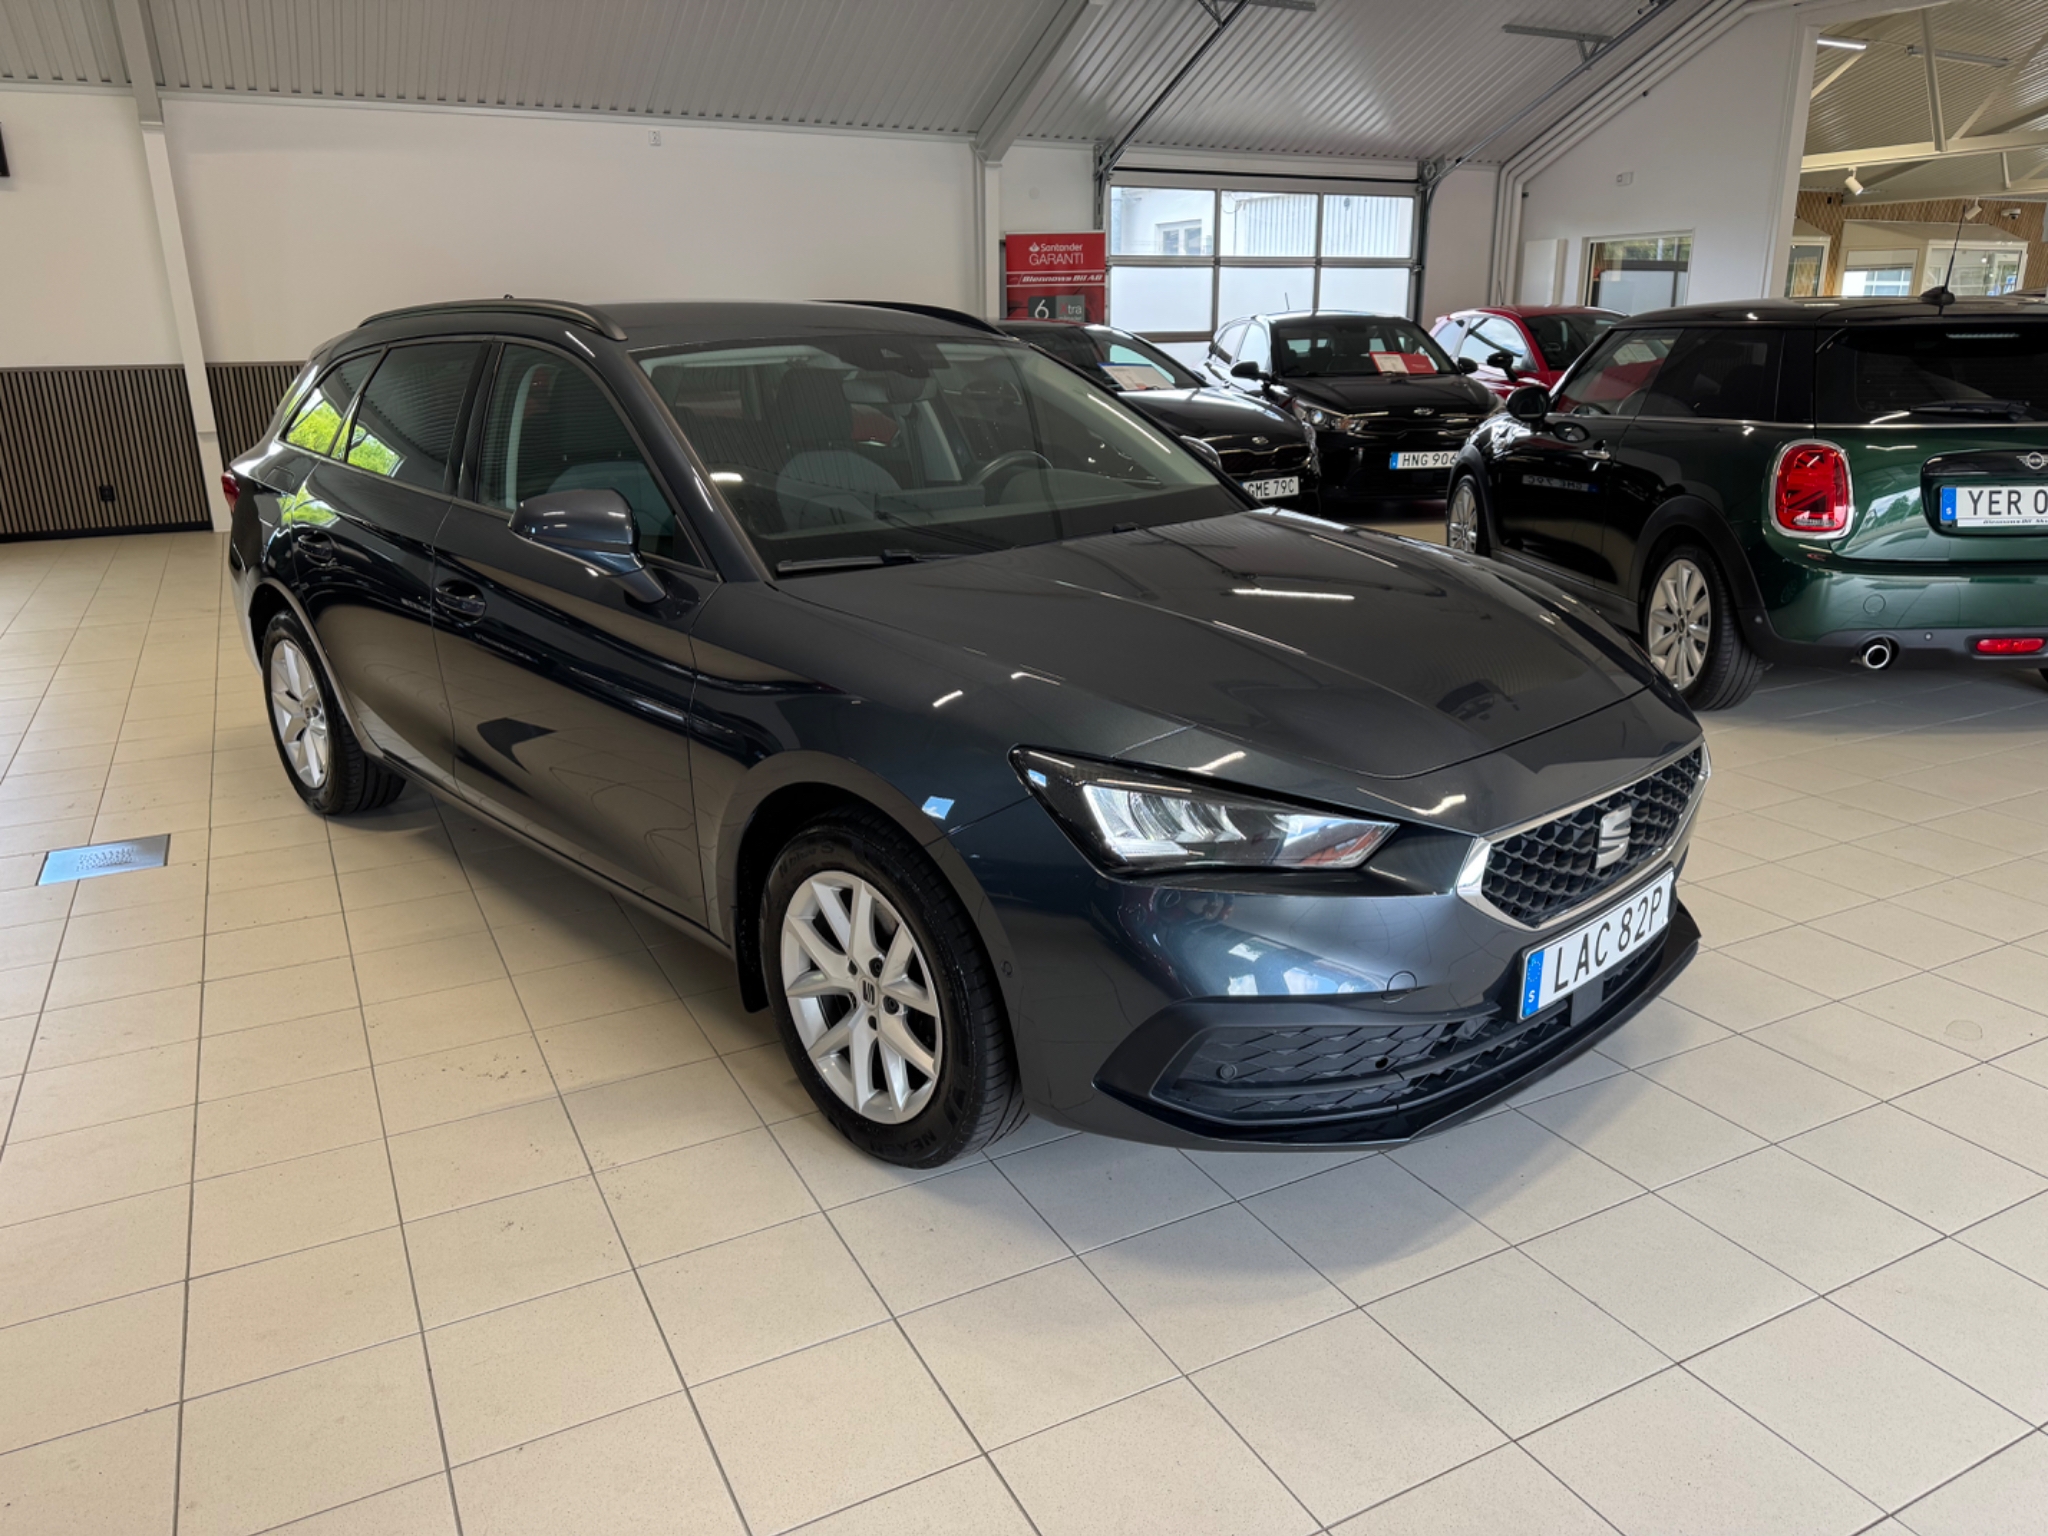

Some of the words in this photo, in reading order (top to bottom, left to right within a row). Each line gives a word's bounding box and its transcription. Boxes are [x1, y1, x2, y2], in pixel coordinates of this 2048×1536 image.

[1040, 243, 1083, 252] Santander
[1029, 252, 1083, 266] GARANTI
[1034, 299, 1050, 319] 6
[1402, 454, 1429, 467] HNG
[1247, 481, 1270, 497] GME
[1273, 478, 1295, 495] 79C
[1967, 489, 2022, 516] YER
[1554, 922, 1611, 993] LAC
[1617, 886, 1663, 952] 82P
[1528, 990, 1535, 1003] S
